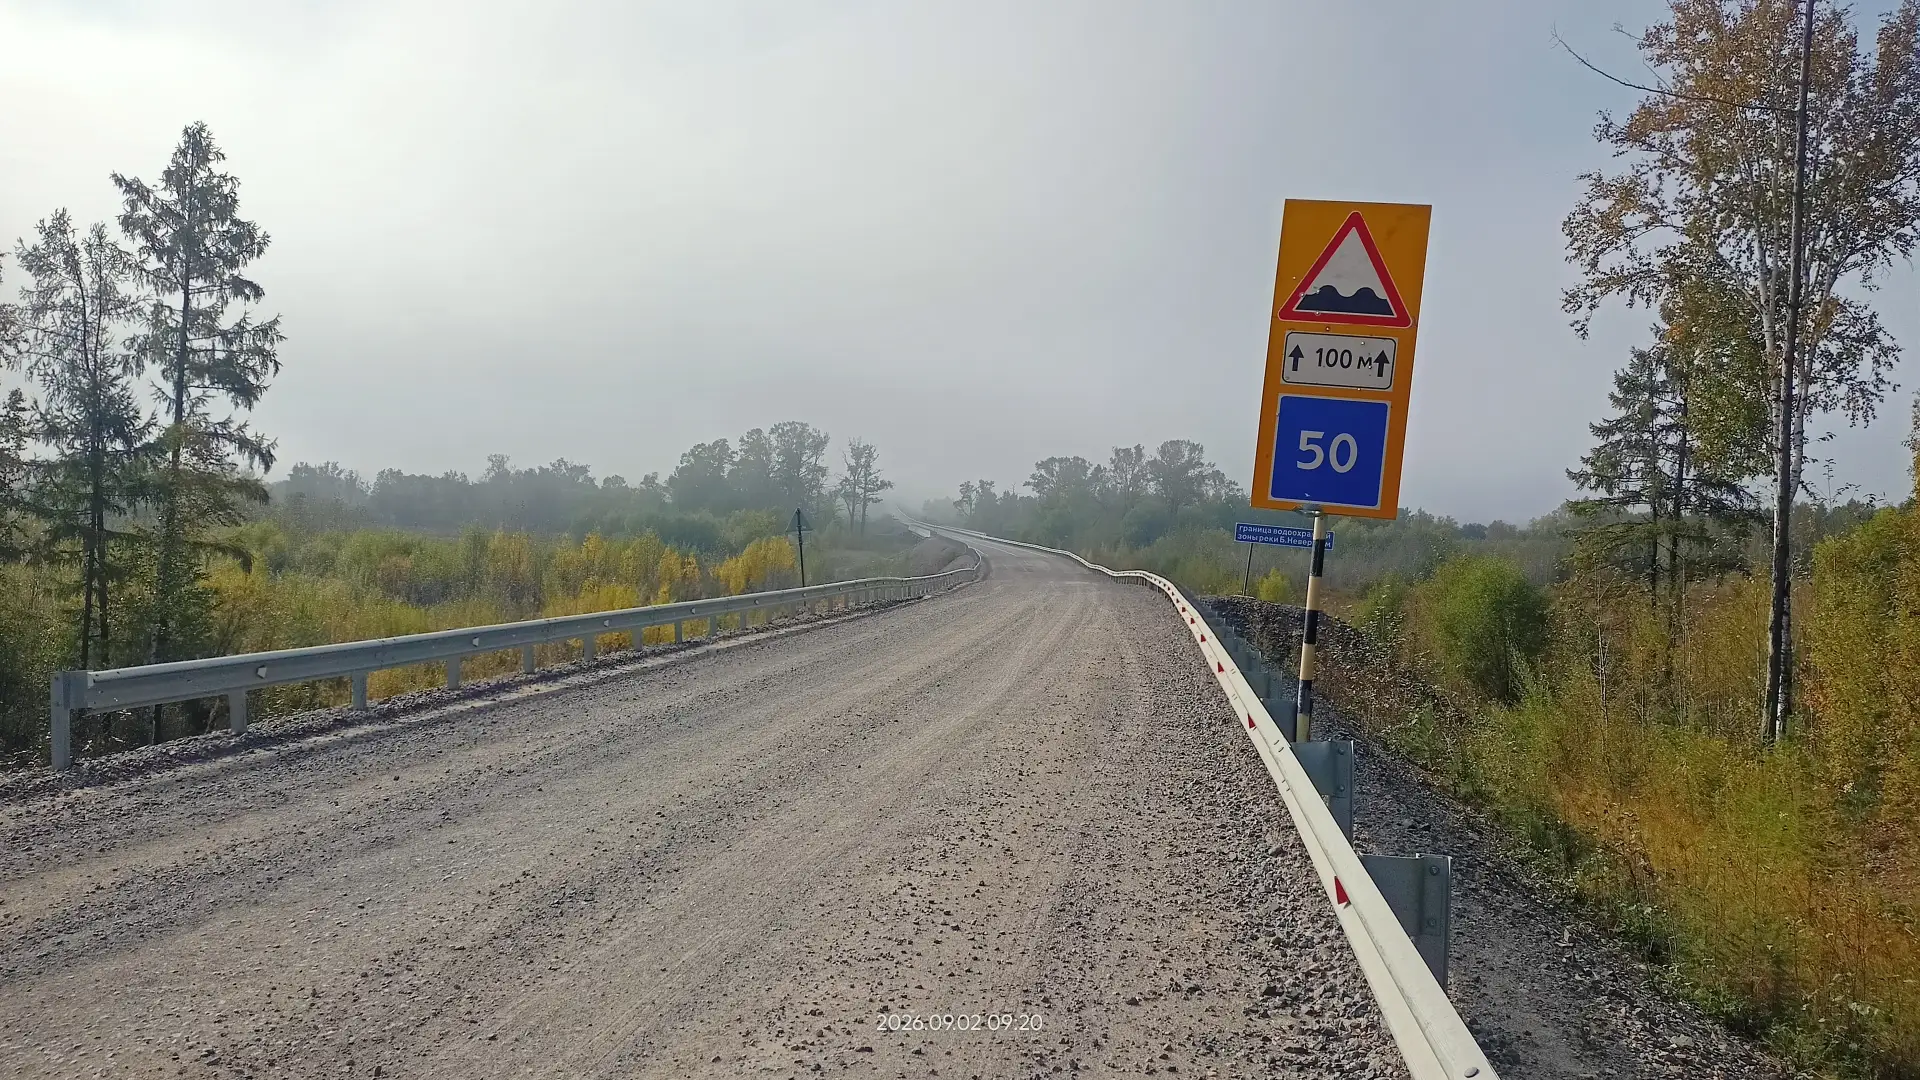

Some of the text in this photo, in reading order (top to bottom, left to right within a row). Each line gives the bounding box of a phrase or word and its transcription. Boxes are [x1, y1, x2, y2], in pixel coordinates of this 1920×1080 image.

[1315, 347, 1373, 370] 100 м
[1296, 430, 1358, 474] 50
[1237, 533, 1258, 541] зоны
[1258, 535, 1279, 543] реки
[1239, 525, 1331, 540] граница водоохрай
